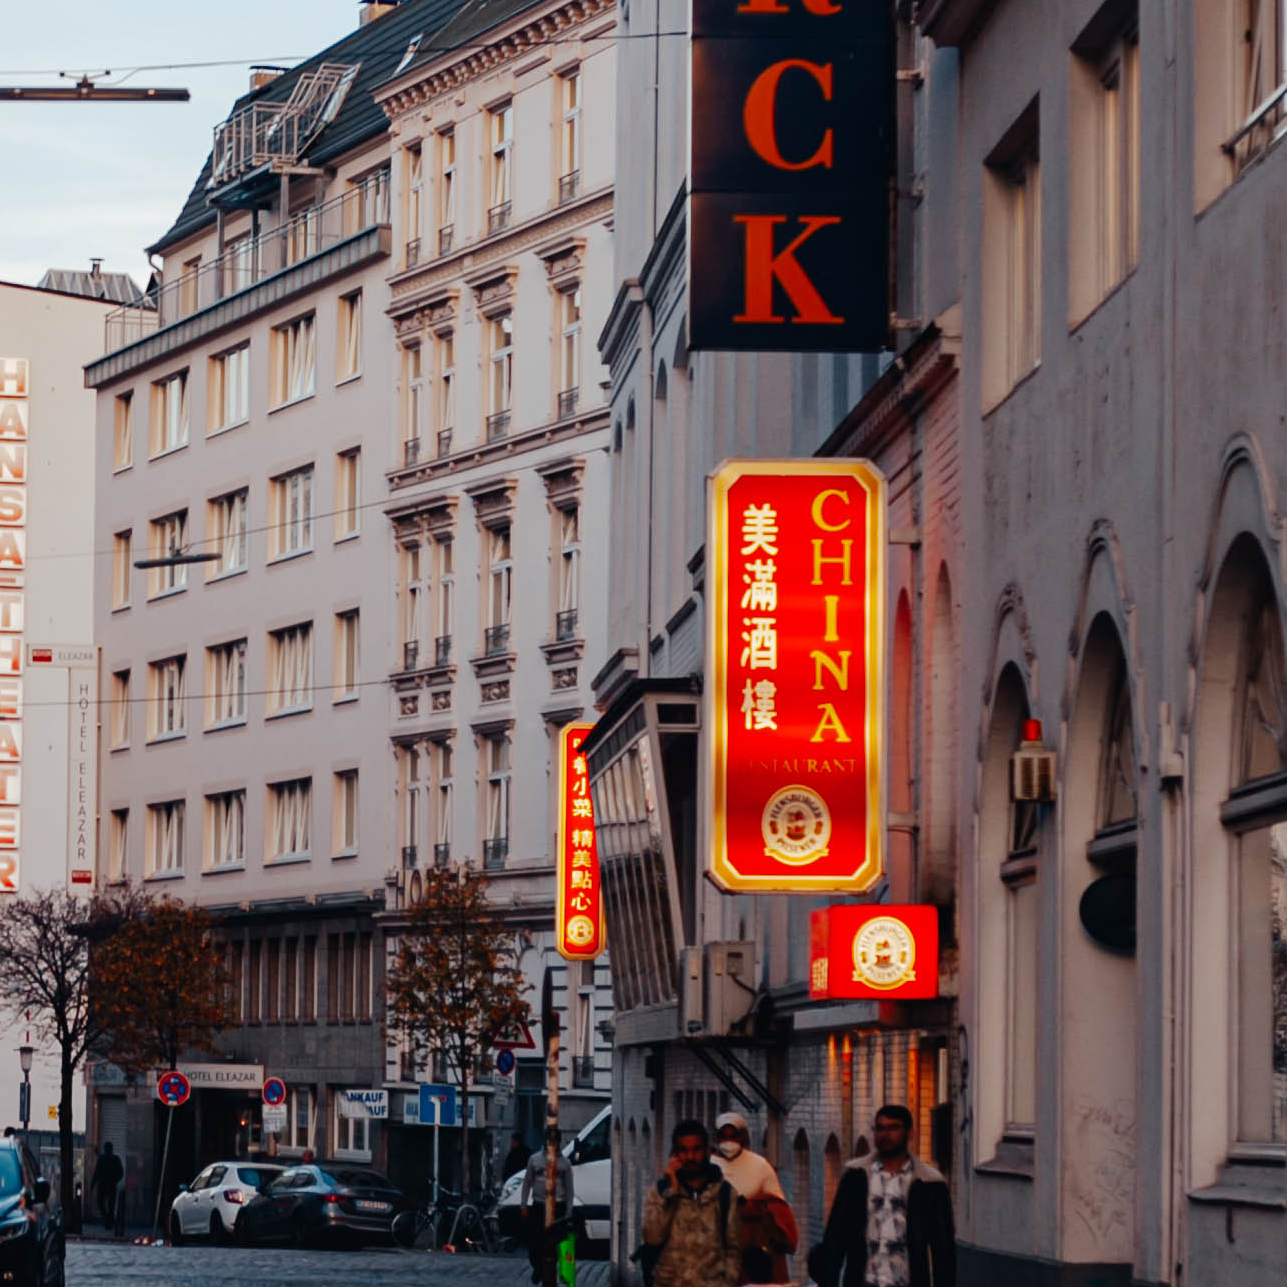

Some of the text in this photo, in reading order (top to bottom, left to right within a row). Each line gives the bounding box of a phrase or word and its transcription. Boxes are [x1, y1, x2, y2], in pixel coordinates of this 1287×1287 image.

[741, 503, 779, 730] 美滿酒樓
[811, 488, 853, 743] CHINA
[79, 684, 89, 753] HOTEL
[739, 758, 856, 775] ESTAURANT
[77, 762, 87, 859] ELEAZAR
[215, 1071, 256, 1082] ELEAZAR
